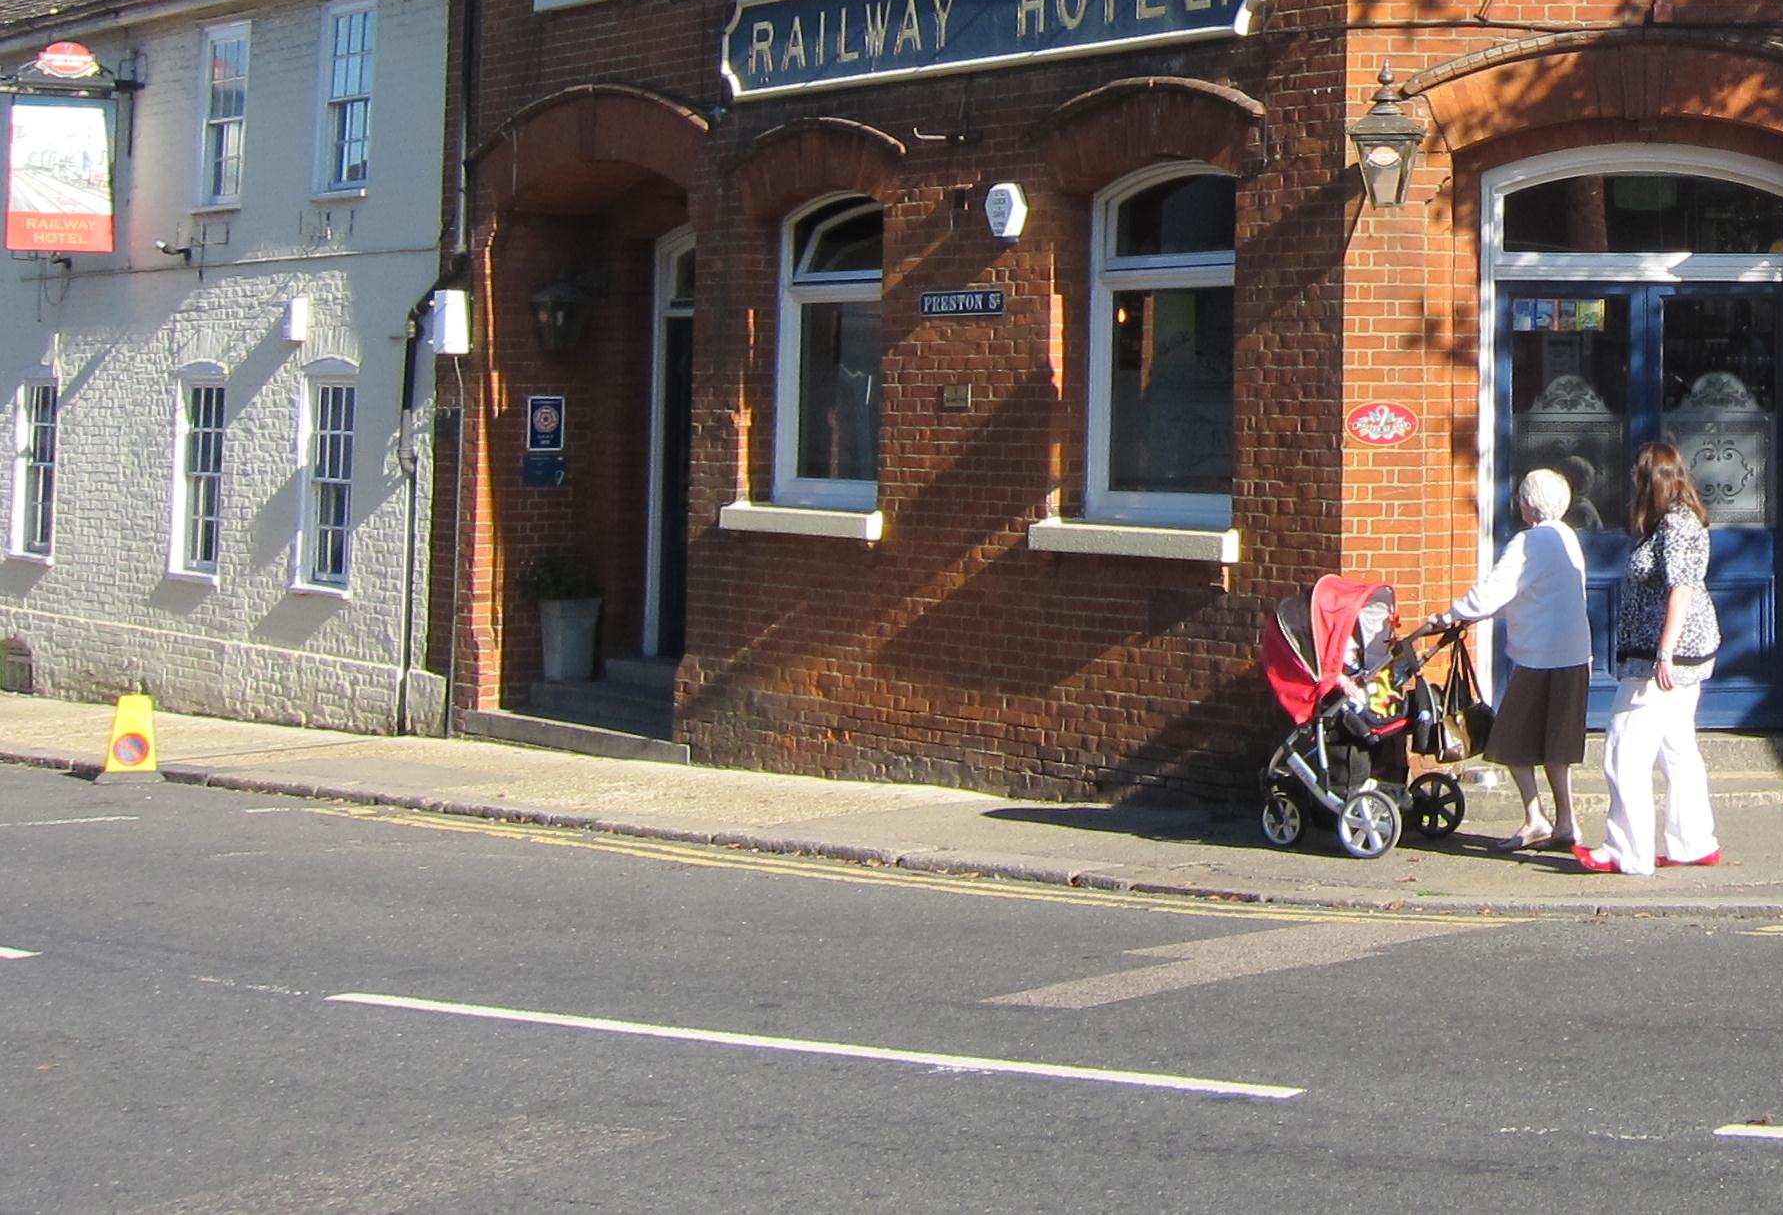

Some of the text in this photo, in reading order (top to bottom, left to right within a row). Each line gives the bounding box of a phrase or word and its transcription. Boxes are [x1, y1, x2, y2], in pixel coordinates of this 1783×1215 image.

[25, 217, 97, 231] RAILWAY
[33, 232, 88, 245] HOTEL
[923, 293, 983, 313] PRESTON
